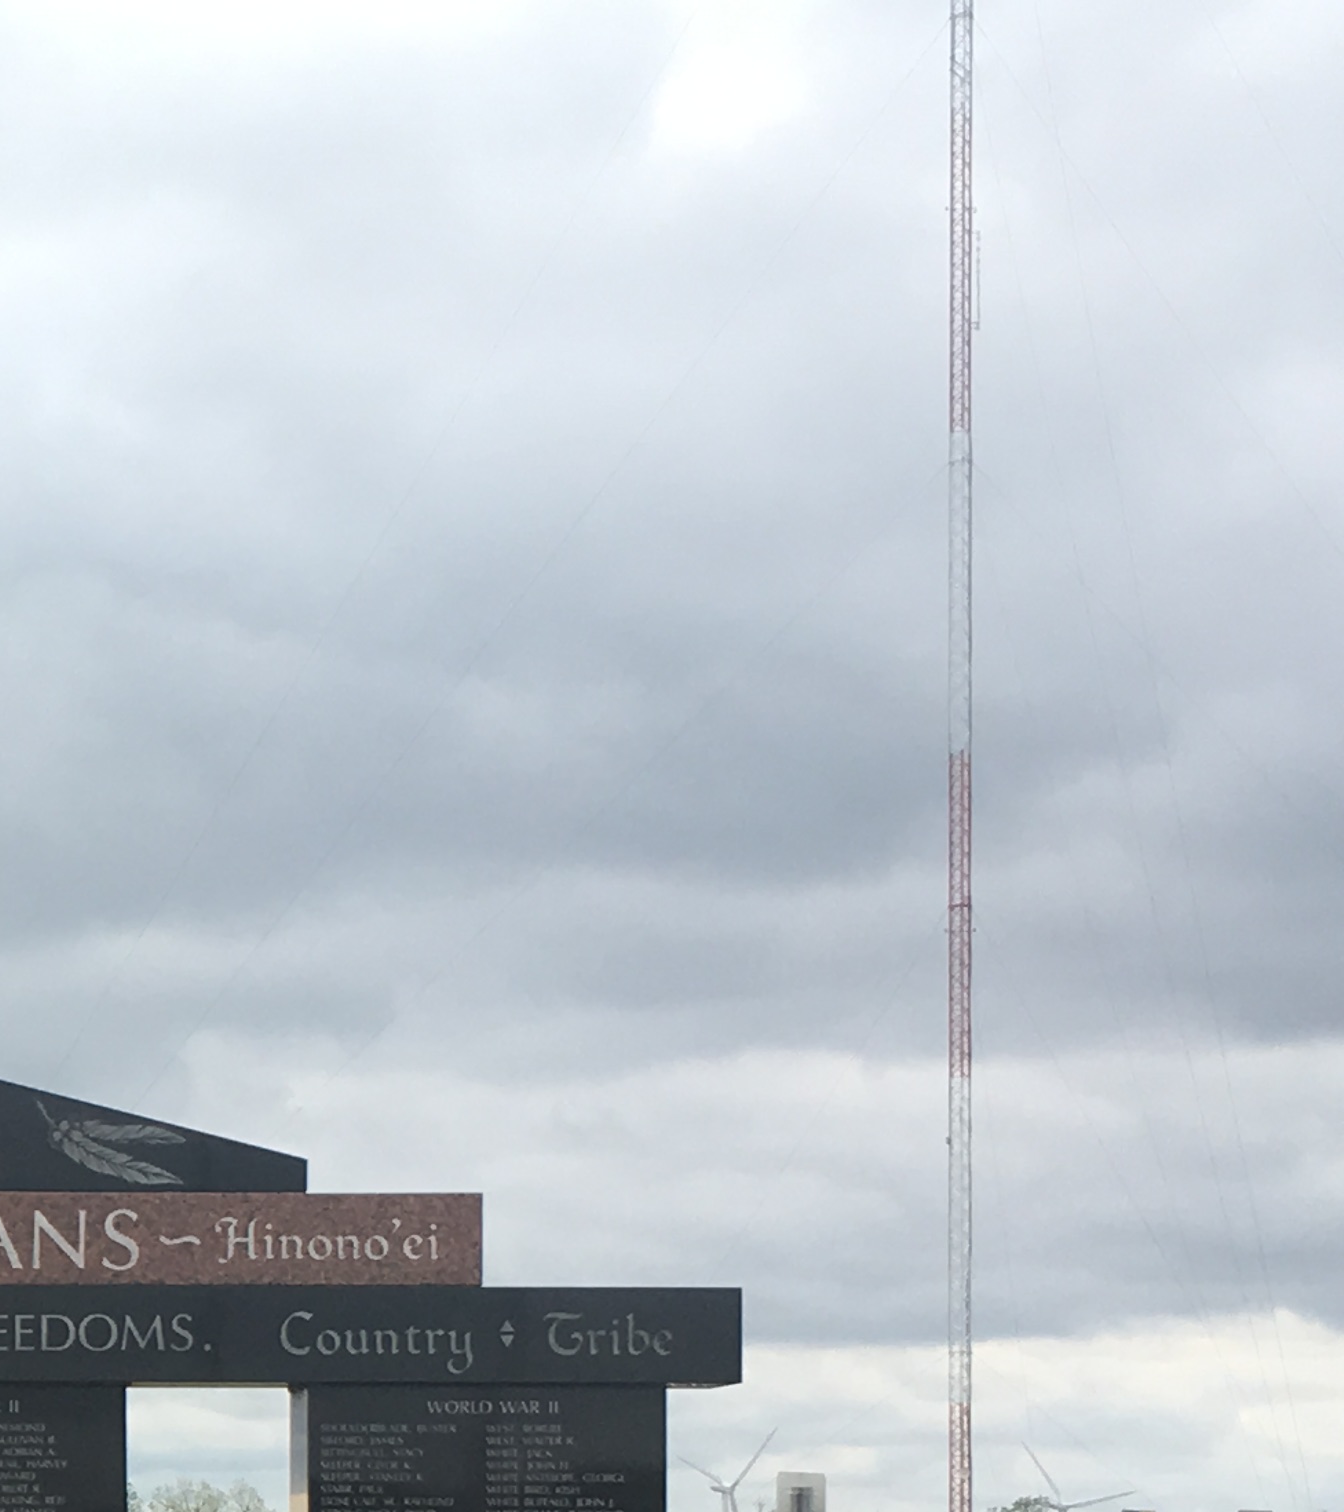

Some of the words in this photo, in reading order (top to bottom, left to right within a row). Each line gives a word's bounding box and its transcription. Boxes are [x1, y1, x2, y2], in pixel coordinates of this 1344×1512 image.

[215, 1217, 439, 1265] Hinono'ei
[279, 1311, 474, 1375] Country
[542, 1312, 673, 1357] Tribe
[8, 1399, 20, 1414] II
[426, 1400, 492, 1414] WORLD
[499, 1400, 540, 1414] WAR
[548, 1400, 560, 1414] II
